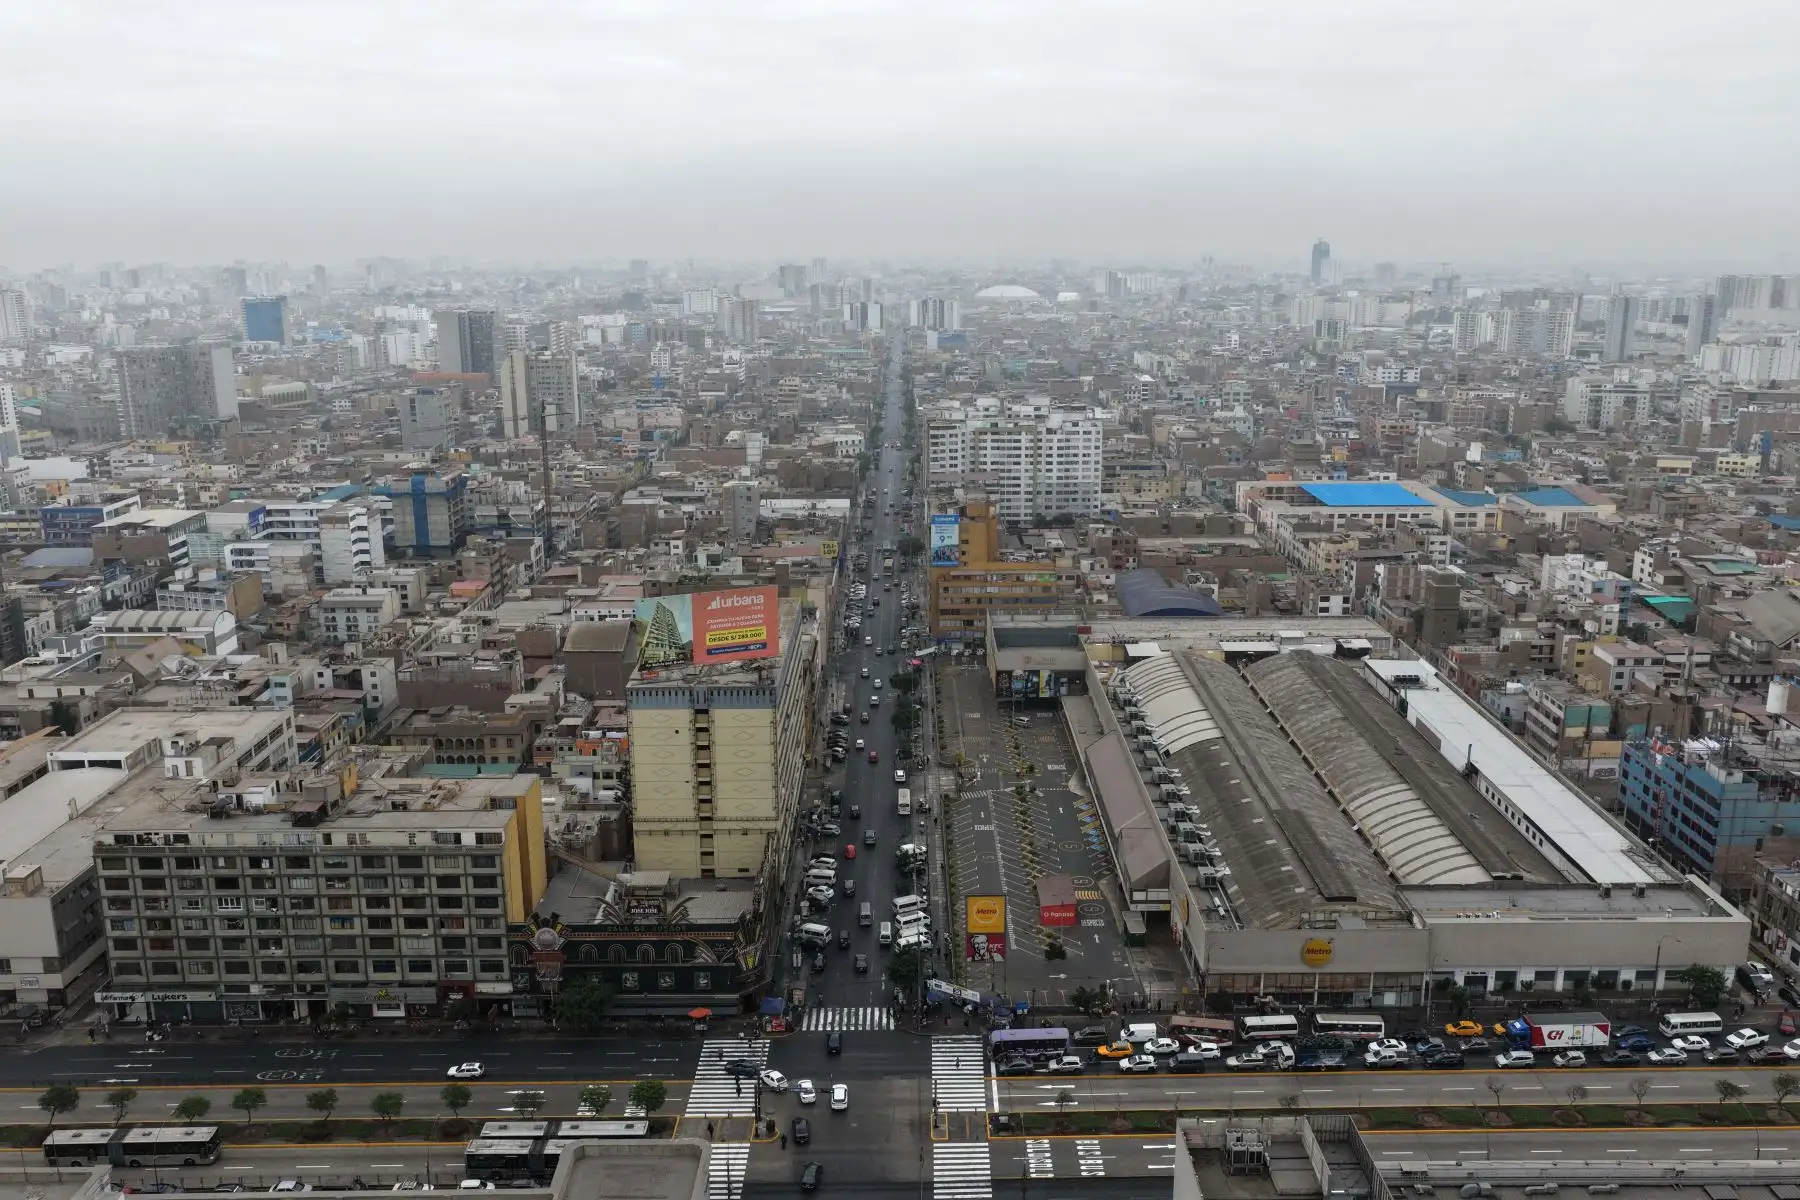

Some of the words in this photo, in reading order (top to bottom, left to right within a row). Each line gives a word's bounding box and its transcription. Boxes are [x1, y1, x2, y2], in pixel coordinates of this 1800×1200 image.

[721, 594, 764, 607] urbana
[708, 635, 729, 643] DESDE
[975, 907, 997, 915] Metro
[1079, 1160, 1105, 1176] BUS
